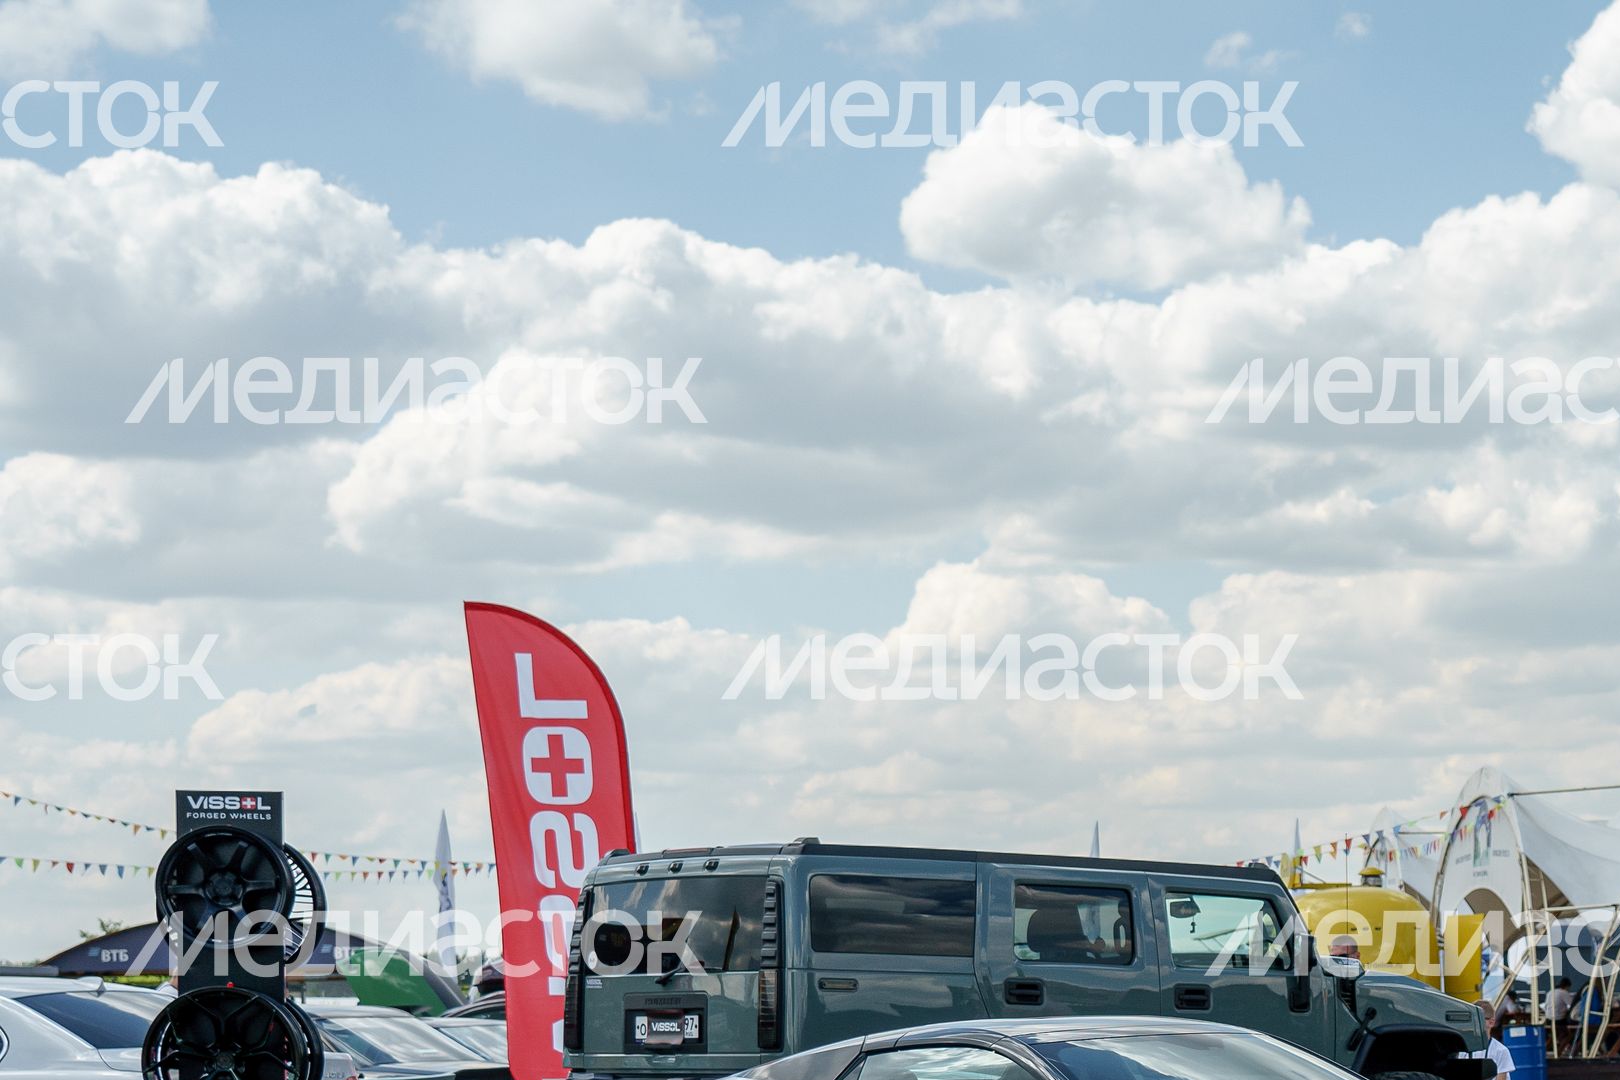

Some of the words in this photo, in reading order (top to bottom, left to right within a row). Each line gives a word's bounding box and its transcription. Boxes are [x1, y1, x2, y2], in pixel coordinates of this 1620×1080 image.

[514, 652, 599, 1054] SOL
[101, 949, 129, 963] ВТБ
[651, 1022, 681, 1032] VISSOL
